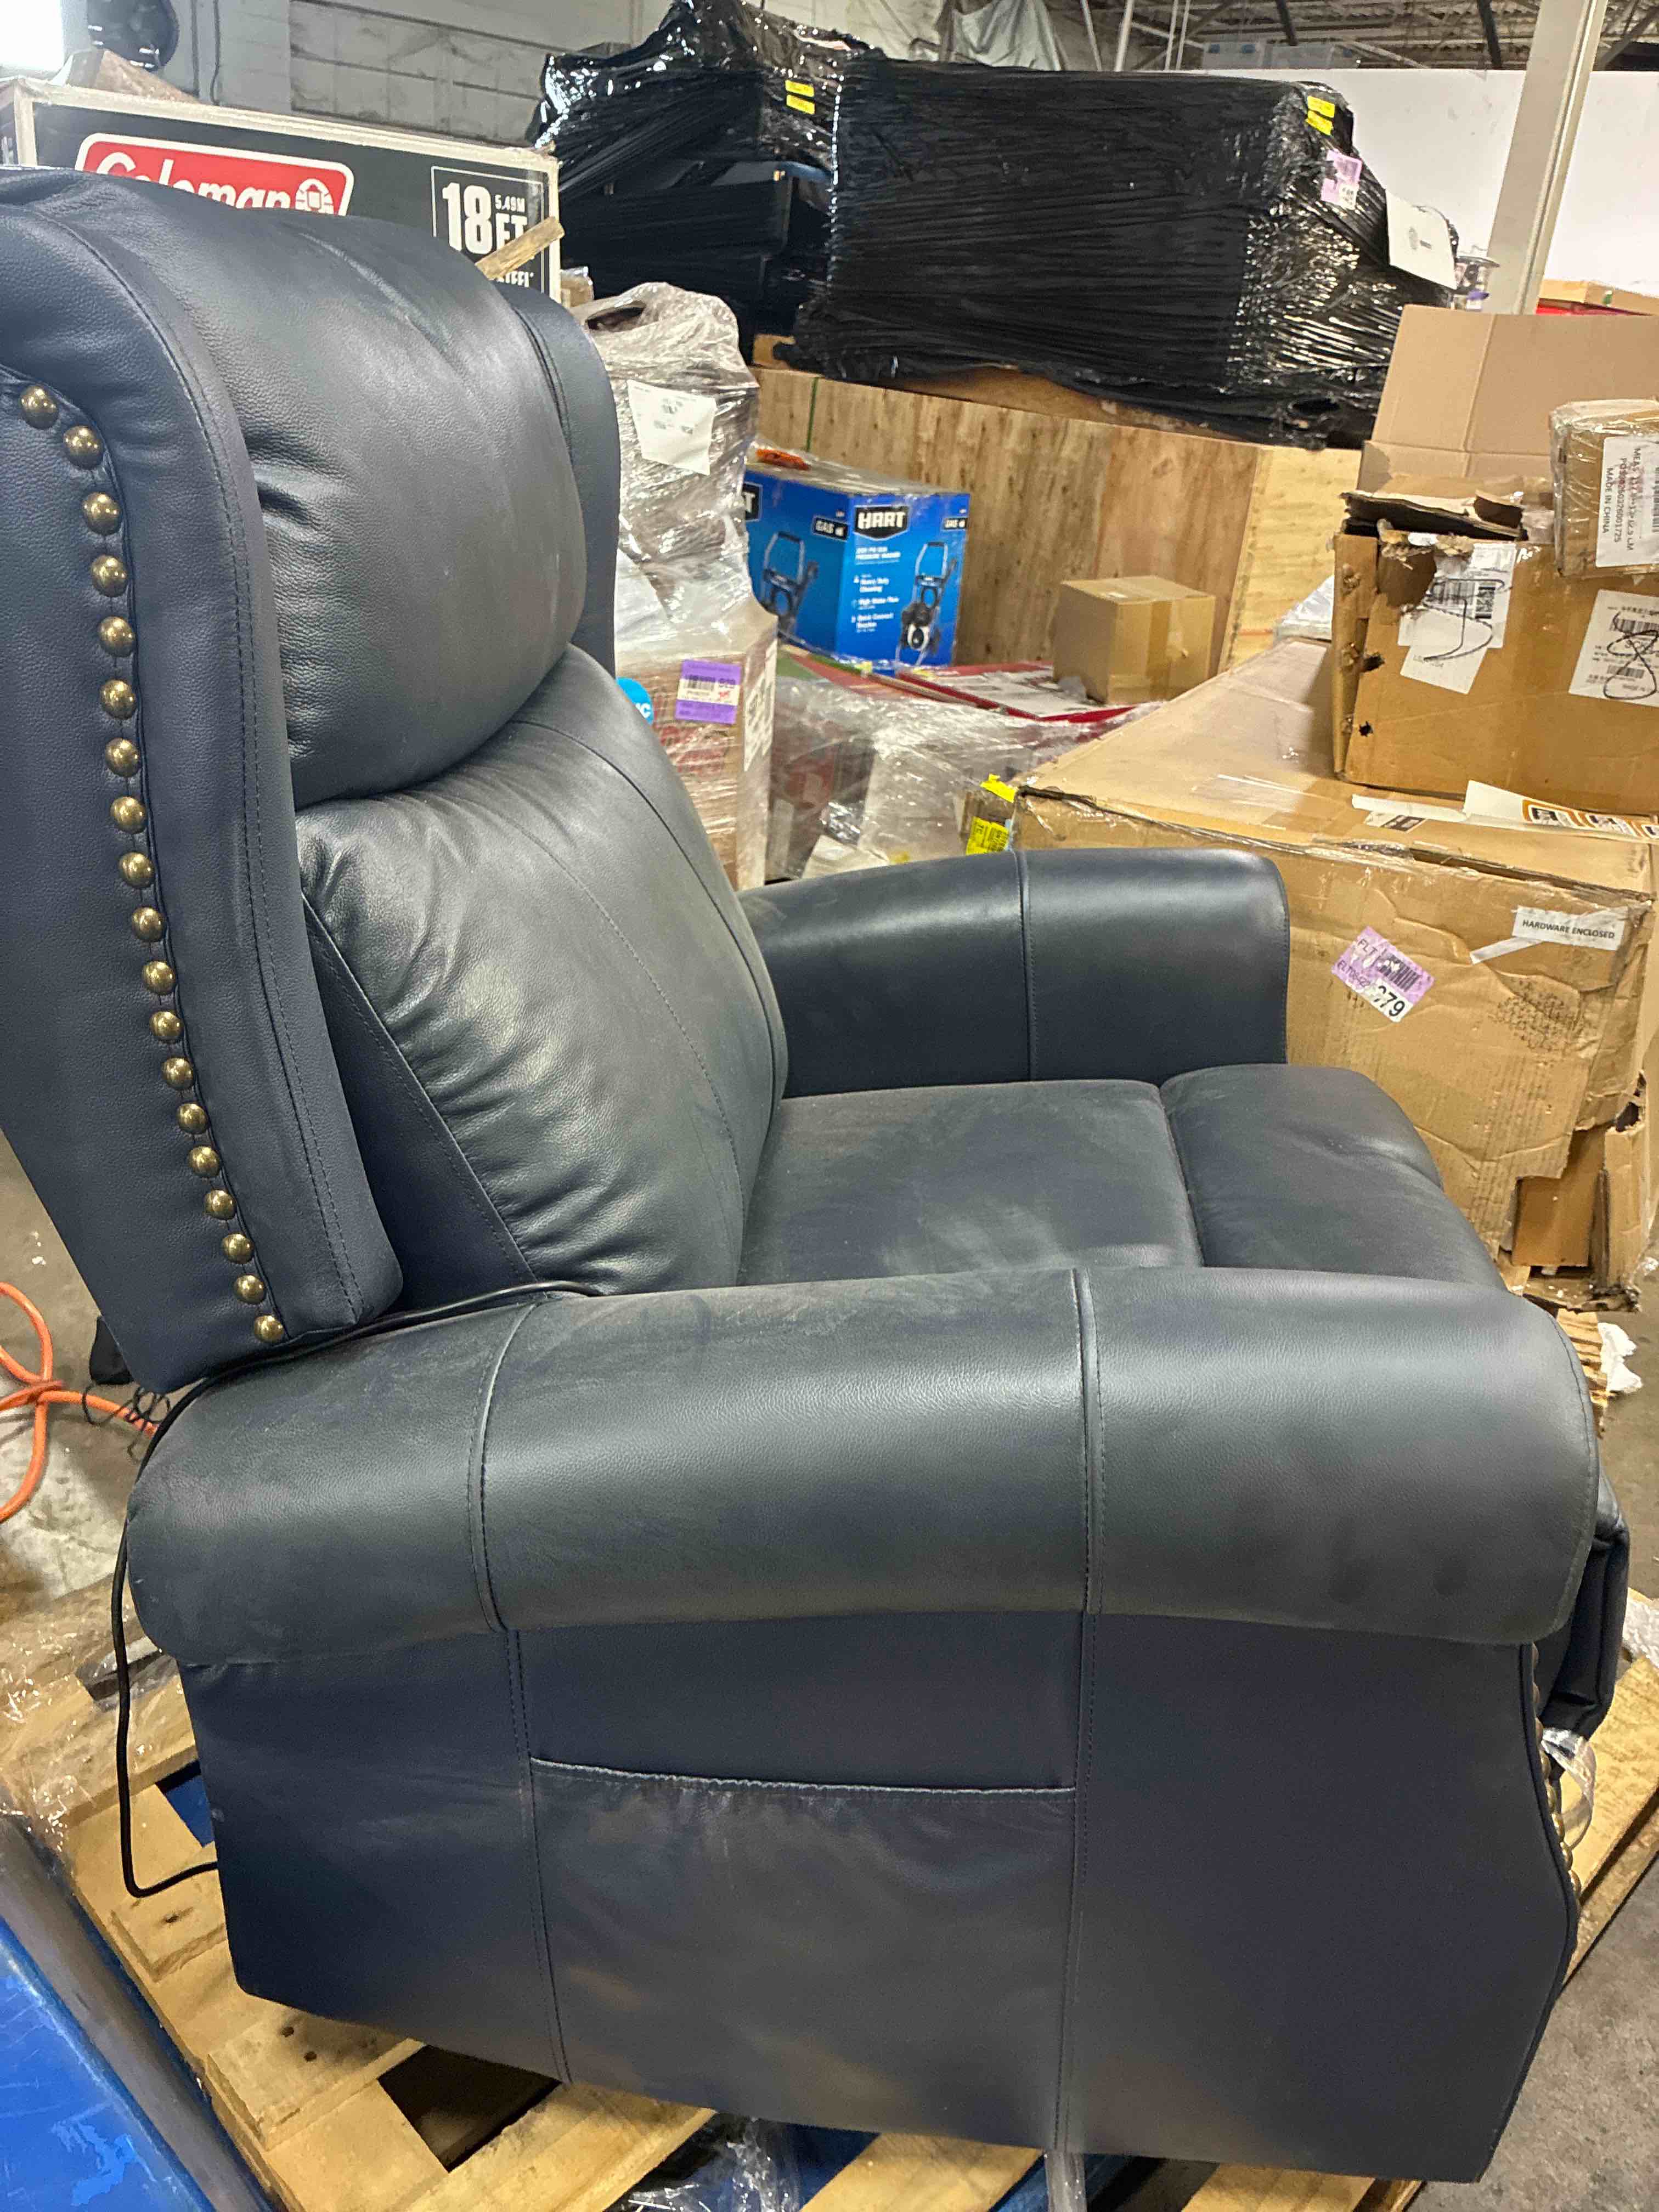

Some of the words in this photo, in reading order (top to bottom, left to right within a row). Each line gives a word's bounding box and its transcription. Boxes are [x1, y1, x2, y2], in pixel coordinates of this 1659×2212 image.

[442, 182, 493, 255] 18
[495, 212, 527, 250] FT
[1605, 467, 1614, 492] MADE
[1605, 494, 1612, 504] IN
[857, 512, 905, 529] HART
[1602, 506, 1611, 533] CHINA
[1522, 919, 1570, 934] HARDWARE
[1572, 927, 1615, 939] ENCLOSED
[1357, 939, 1378, 956] FLT
